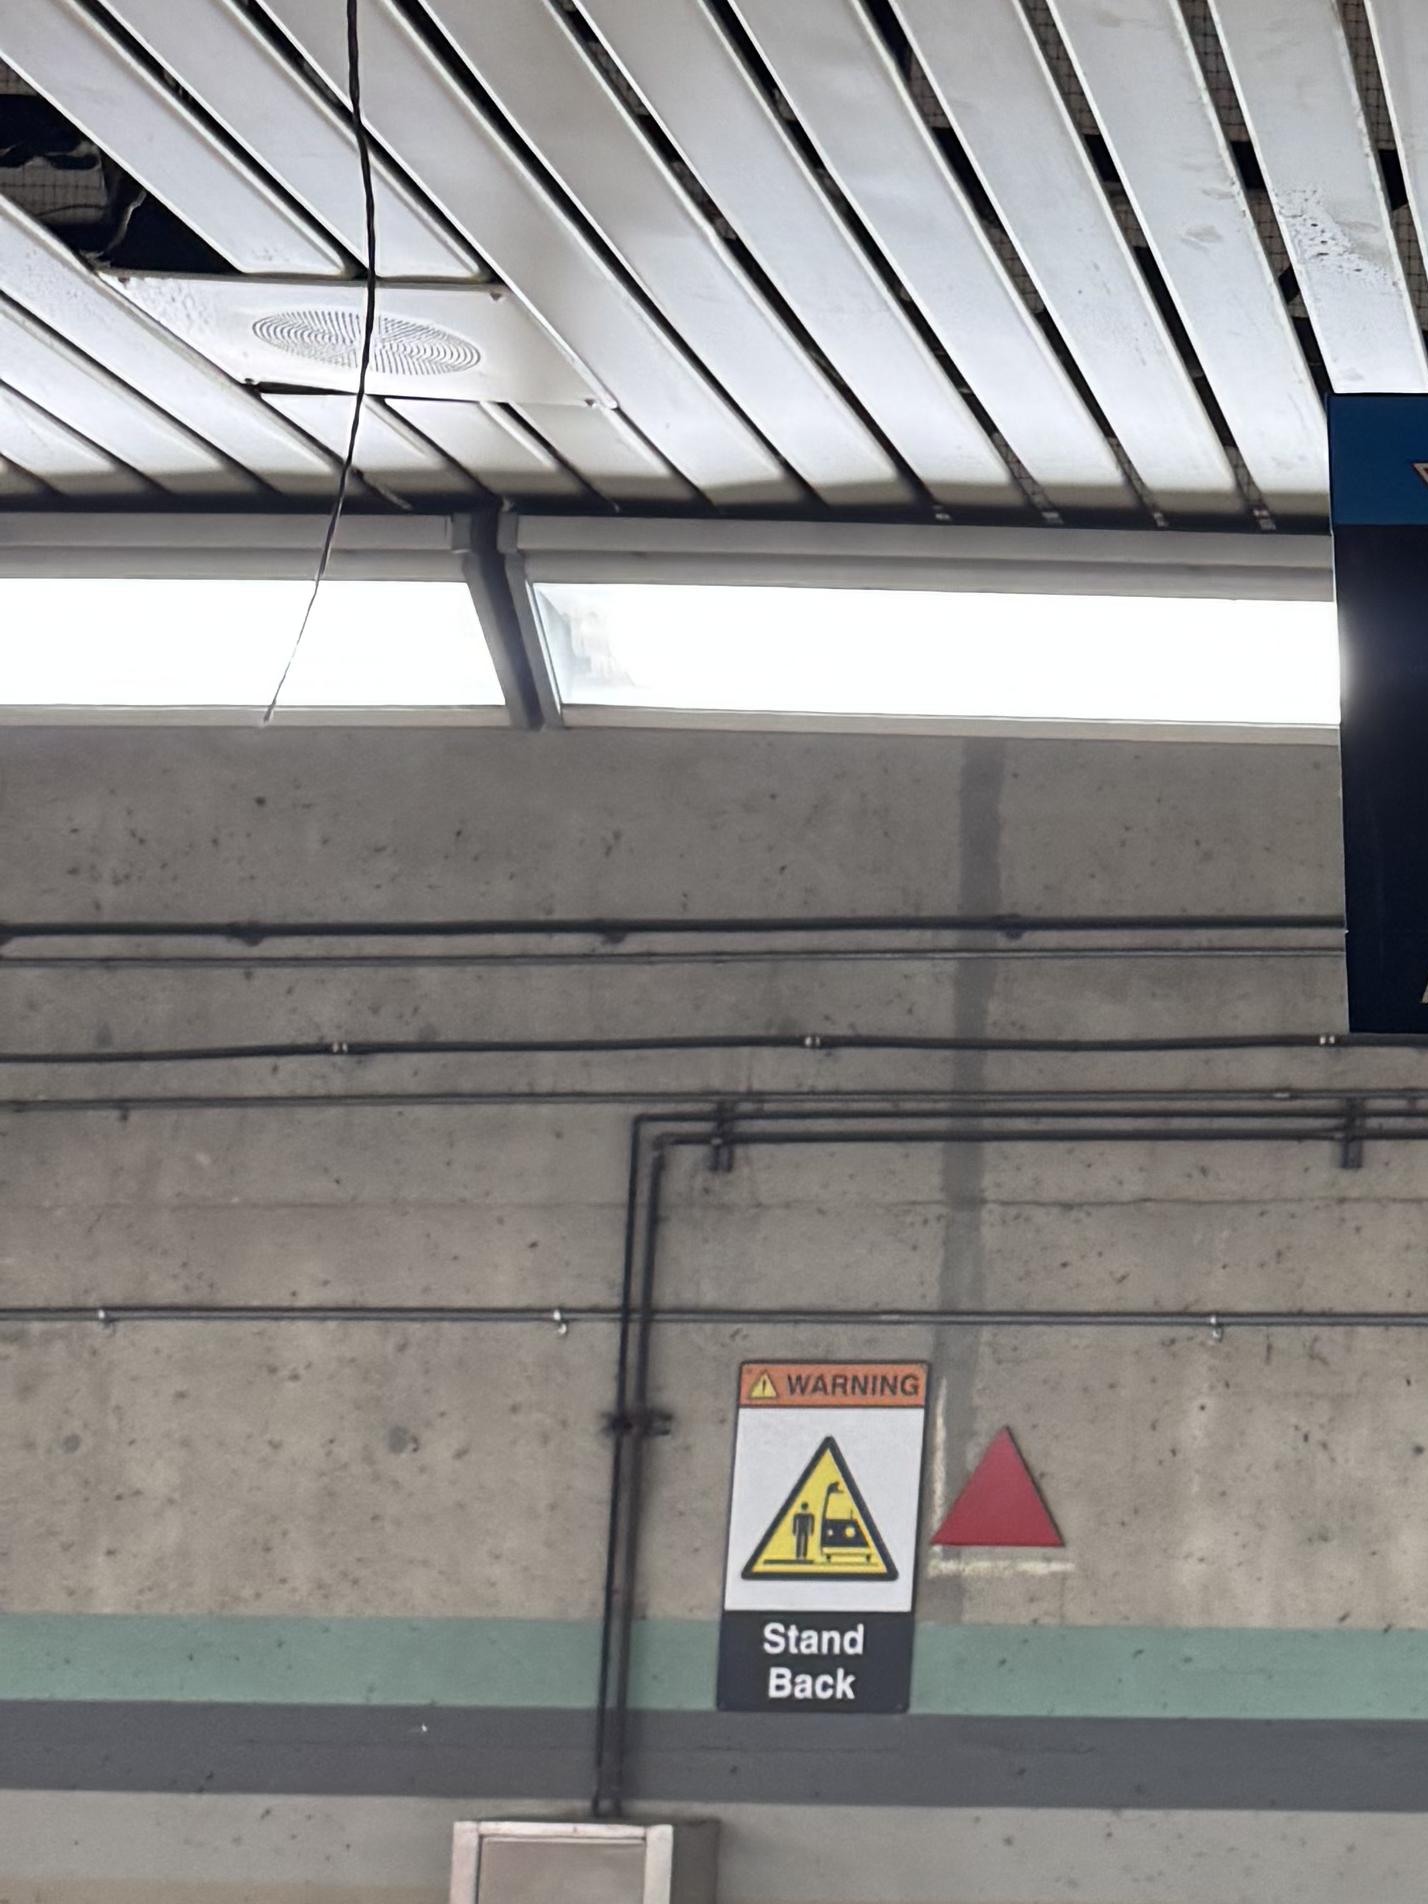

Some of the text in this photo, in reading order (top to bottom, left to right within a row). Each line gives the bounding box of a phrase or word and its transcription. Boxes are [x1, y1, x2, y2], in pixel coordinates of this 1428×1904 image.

[786, 1373, 920, 1397] WARNING
[762, 1621, 866, 1656] Stand
[767, 1666, 857, 1700] Back
